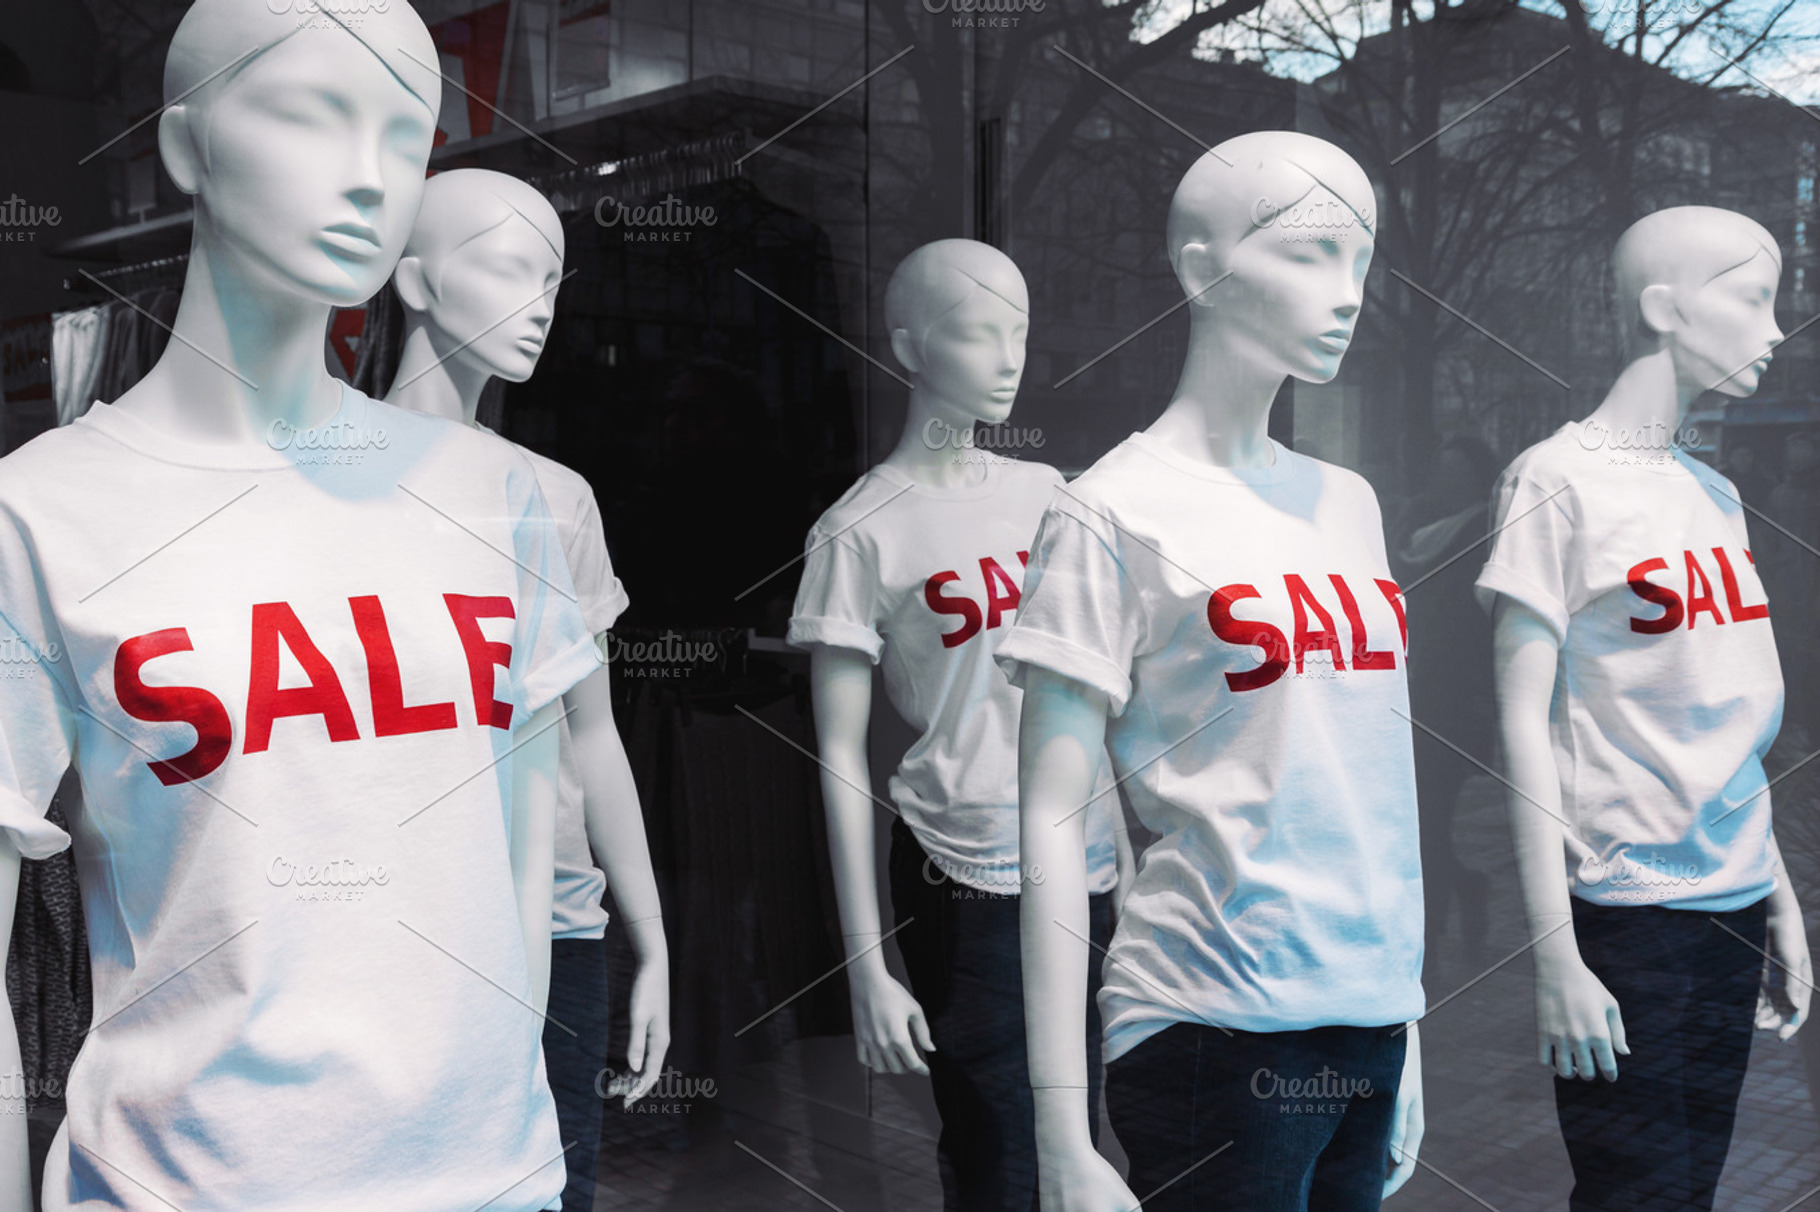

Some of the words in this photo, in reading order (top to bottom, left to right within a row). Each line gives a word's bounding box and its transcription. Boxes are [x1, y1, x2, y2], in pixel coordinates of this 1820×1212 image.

[924, 550, 1029, 649] SA
[1627, 547, 1770, 635] SAL
[114, 593, 516, 786] SALE
